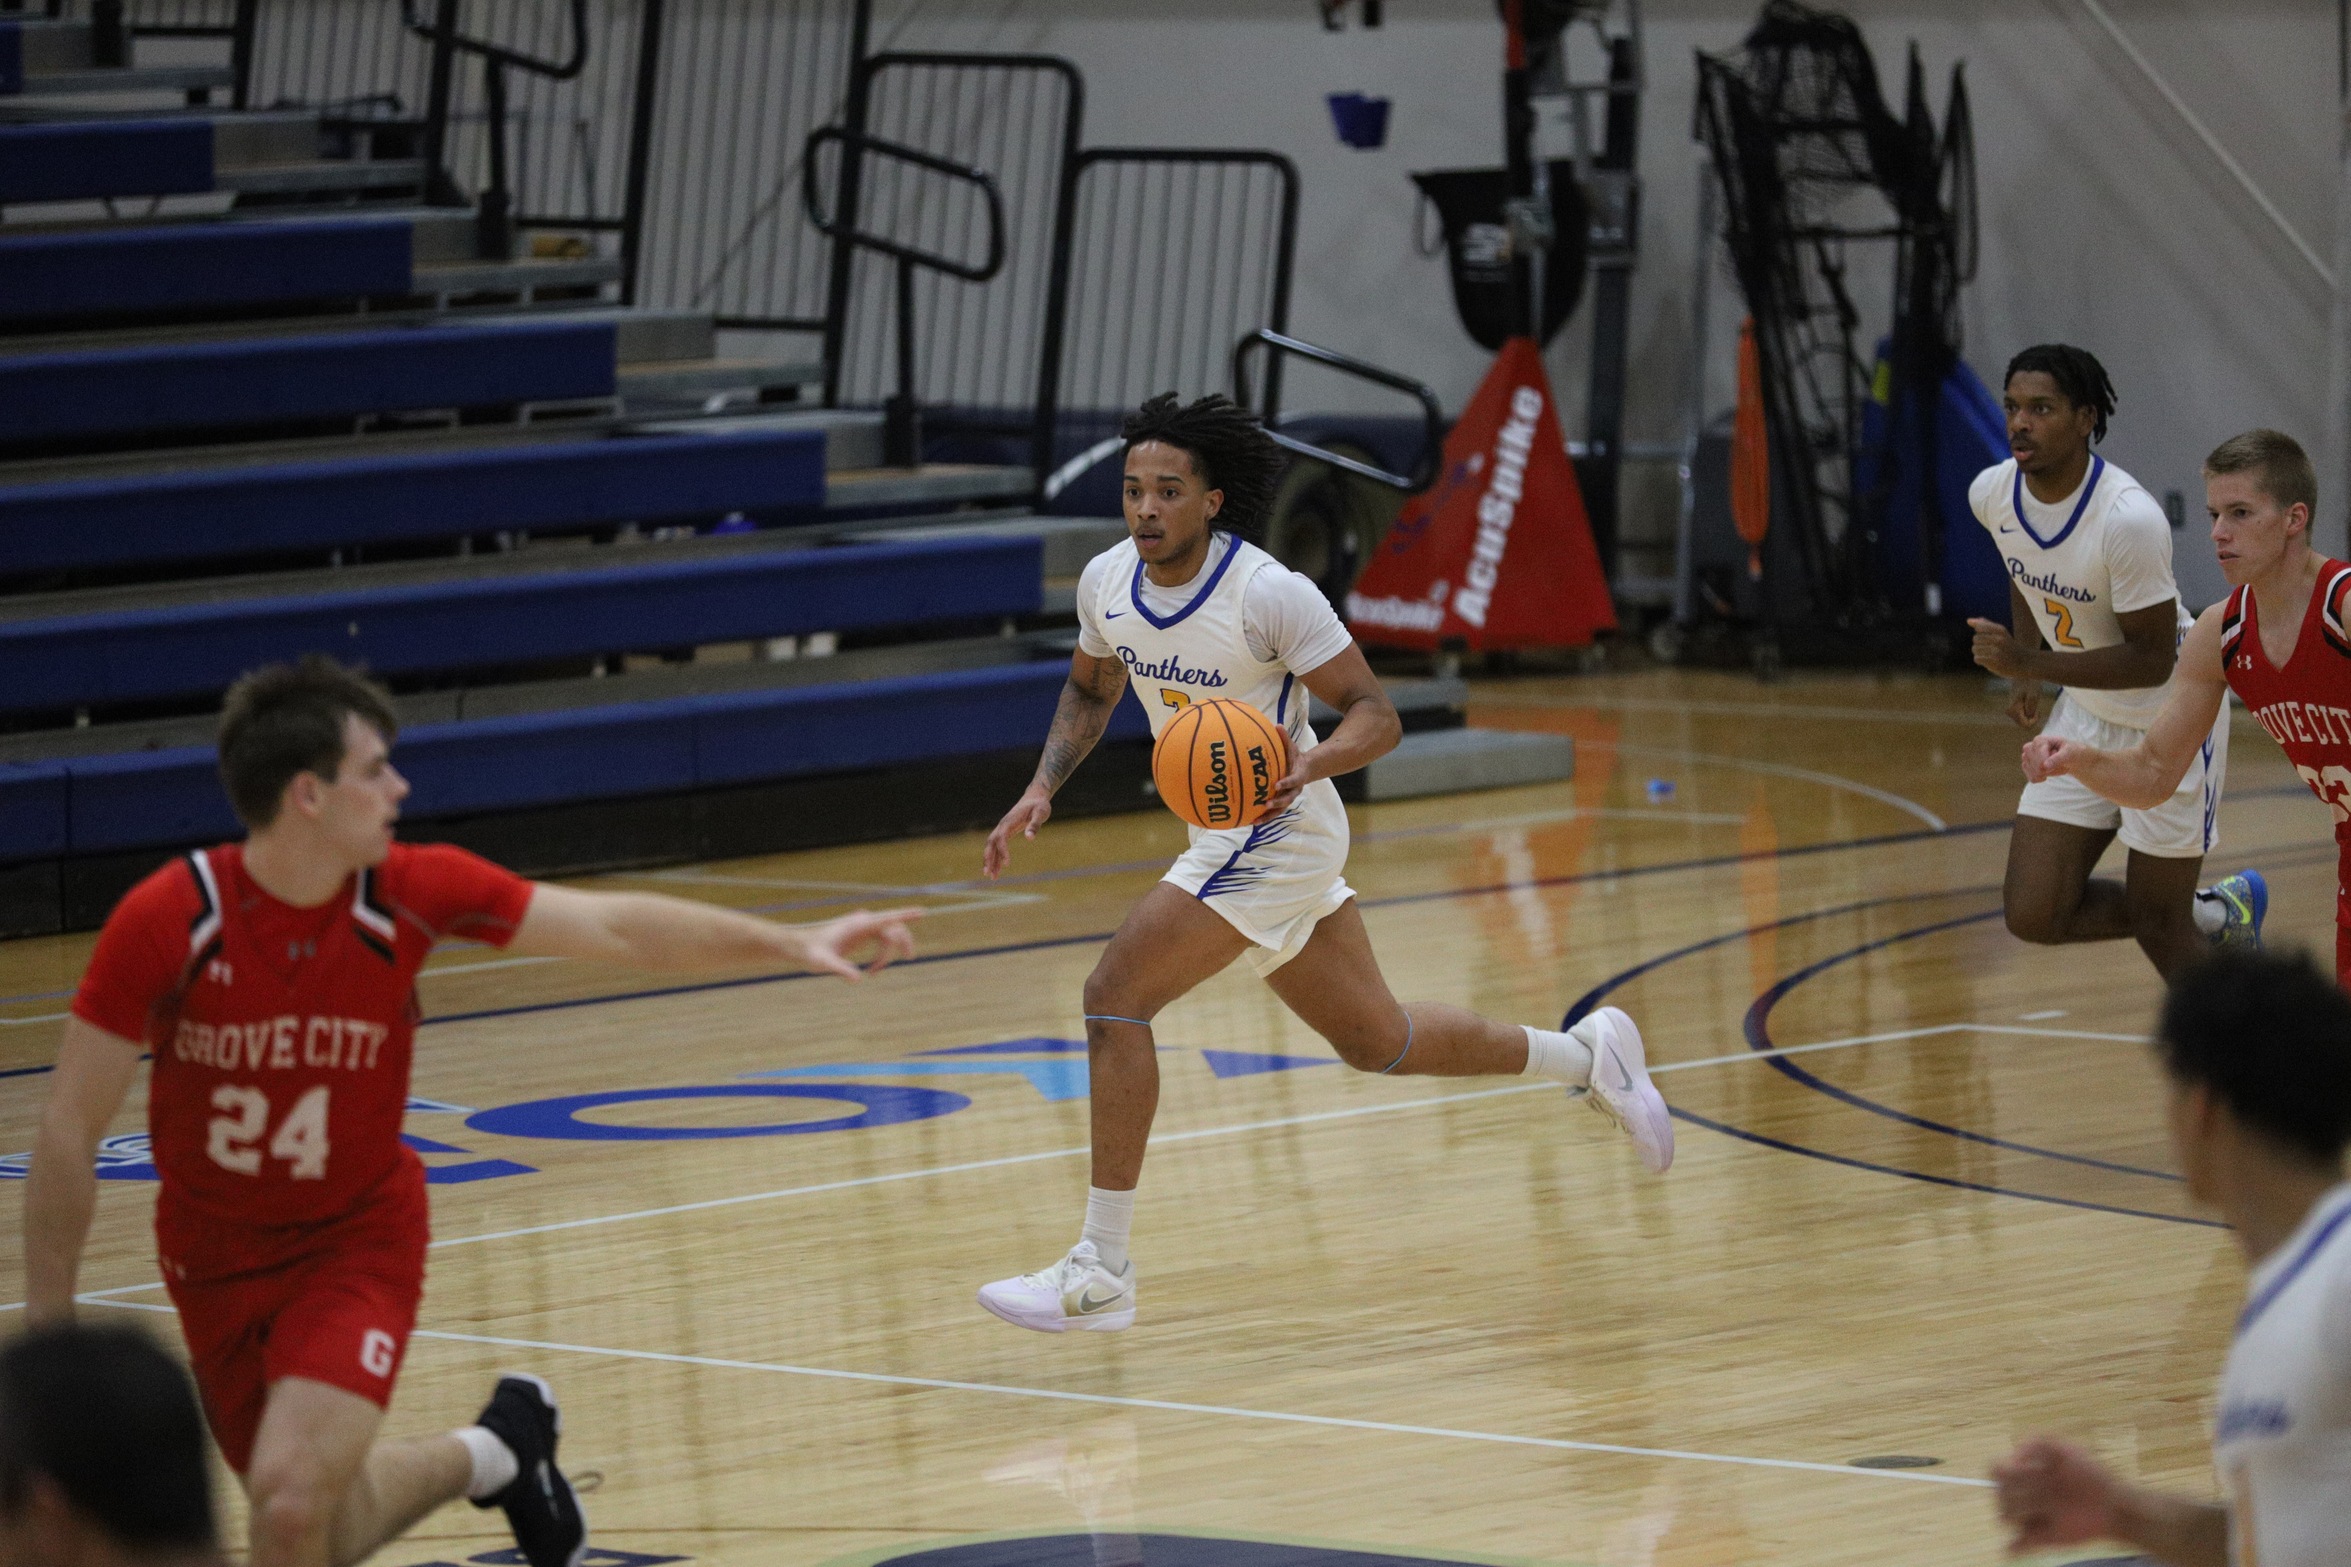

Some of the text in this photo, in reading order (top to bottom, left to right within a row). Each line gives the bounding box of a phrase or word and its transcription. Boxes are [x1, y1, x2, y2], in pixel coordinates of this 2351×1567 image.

[1454, 385, 1543, 628] AcuSpike
[2007, 557, 2096, 603] Panthers
[2044, 597, 2084, 649] 2
[1116, 646, 1228, 687] Panthers
[1205, 740, 1231, 823] Wilson
[1248, 745, 1269, 806] NCAA
[174, 1014, 389, 1071] GROVE CITY
[206, 1084, 331, 1180] 24
[361, 1329, 395, 1378] G
